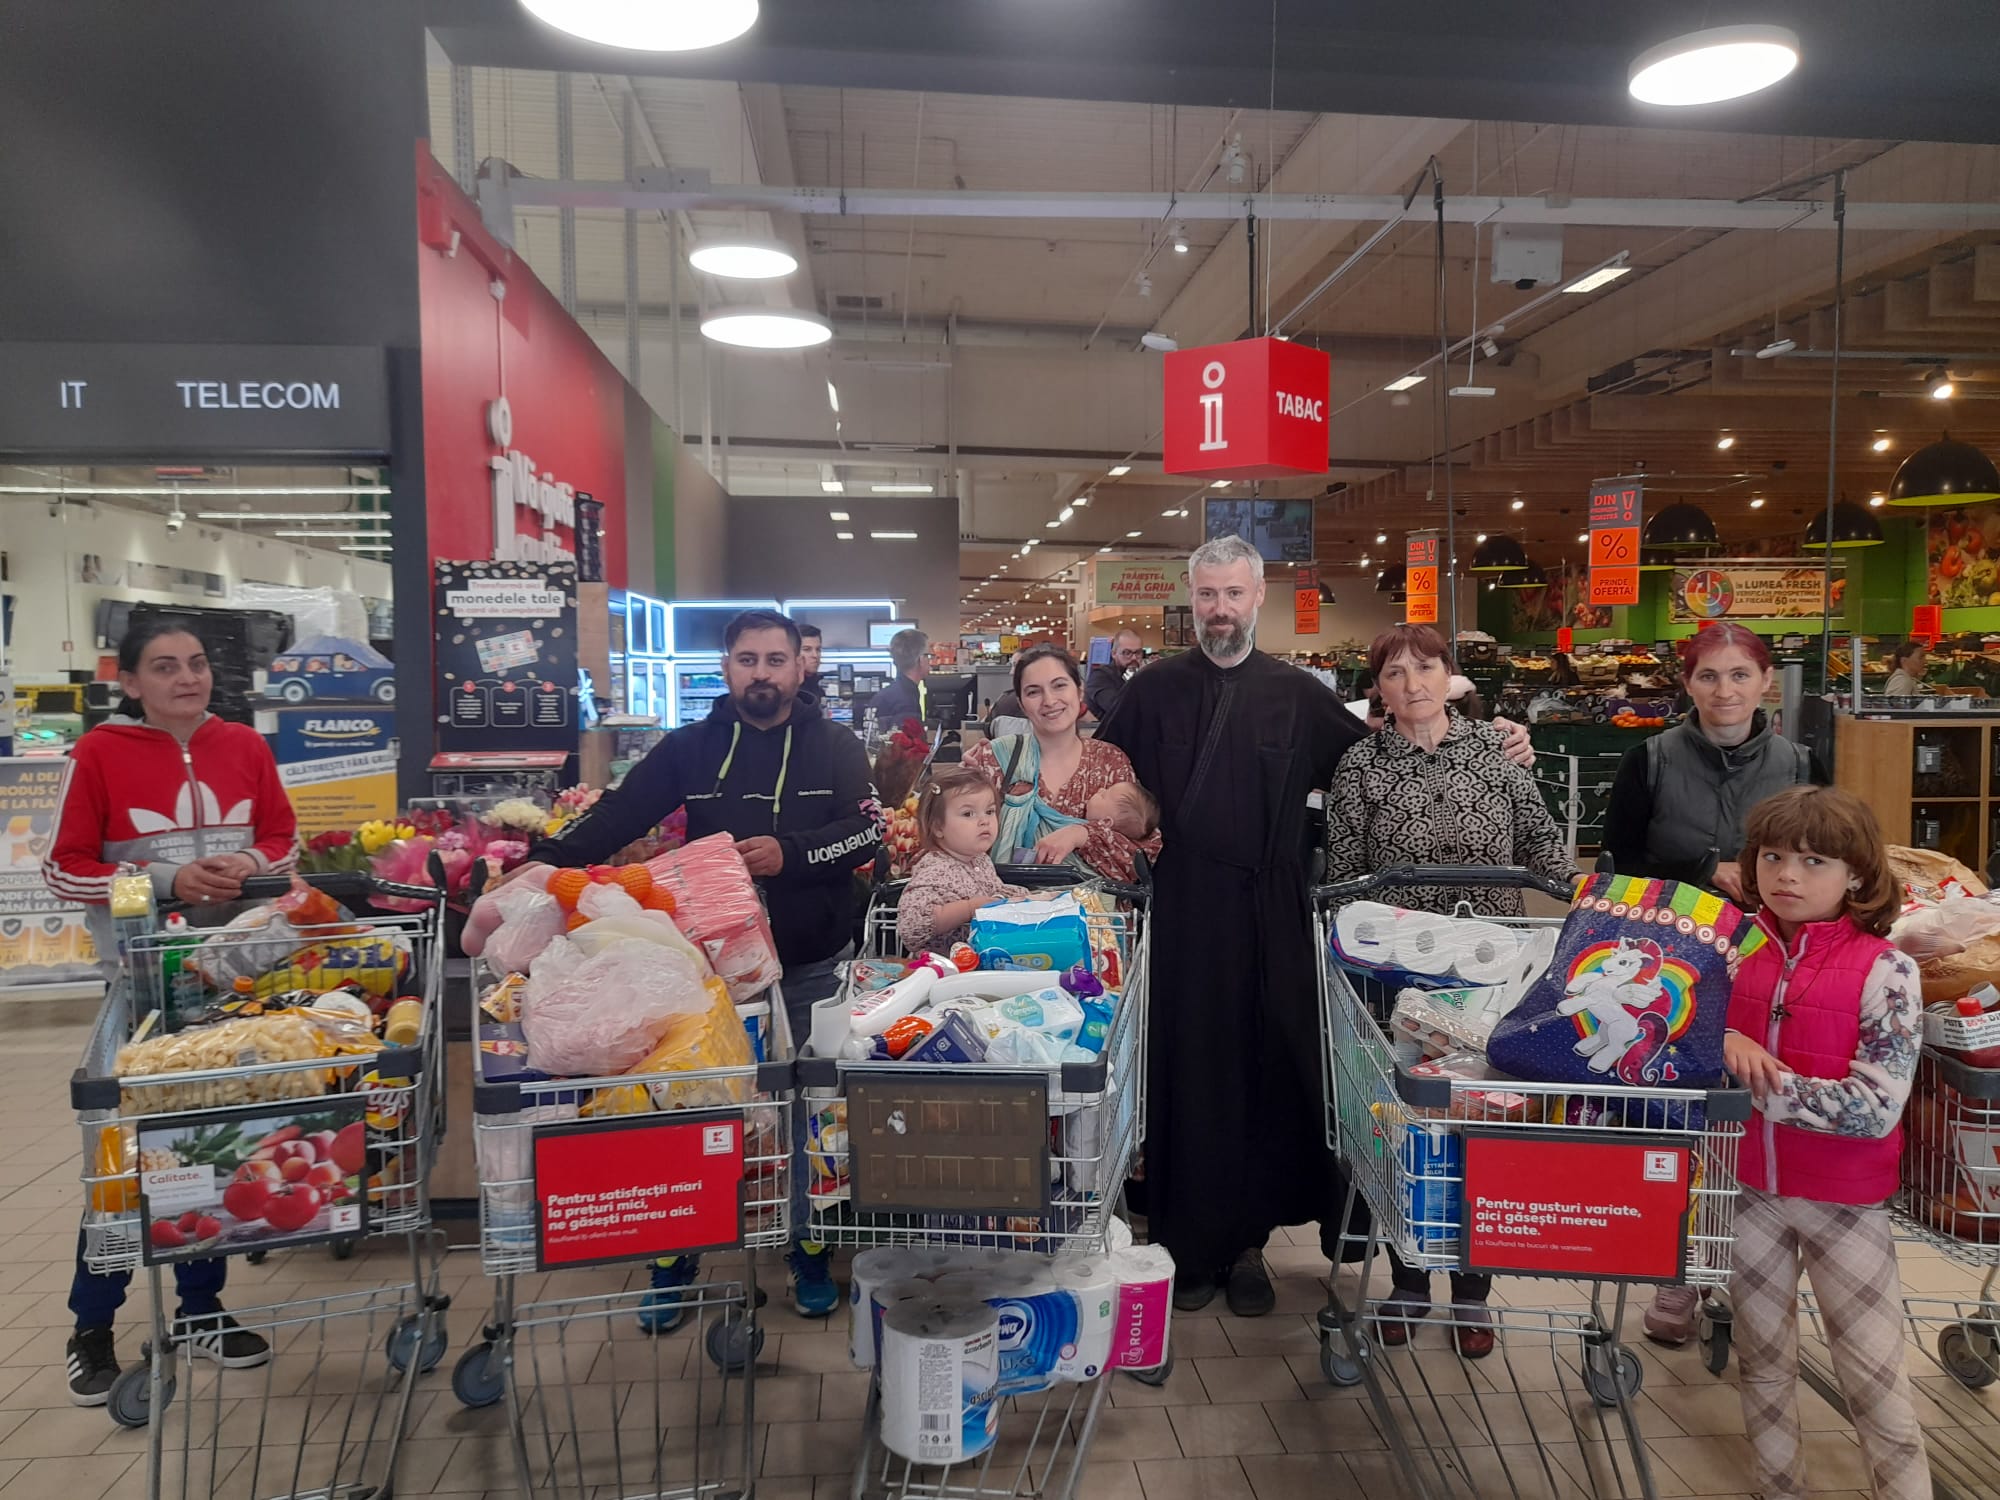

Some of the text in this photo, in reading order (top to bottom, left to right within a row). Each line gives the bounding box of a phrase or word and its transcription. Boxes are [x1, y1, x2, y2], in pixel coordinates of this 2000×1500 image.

[60, 381, 88, 409] IT
[176, 382, 340, 409] TELECOM
[1275, 390, 1323, 423] TABAC
[1593, 494, 1617, 507] DIN
[1593, 586, 1634, 597] OFERTA!
[1599, 578, 1629, 587] PRINDE
[1744, 580, 1783, 590] LUMEA
[1785, 580, 1821, 589] FRESH
[450, 592, 561, 605] monedele tale
[304, 719, 375, 732] FLANCO
[36, 771, 61, 783] DEJ
[0, 785, 46, 797] RODUS
[807, 822, 884, 865] Dimension
[547, 1193, 597, 1207] Pentru
[670, 1180, 703, 1194] mari
[548, 1198, 649, 1219] la prețuri mici,
[1475, 1196, 1643, 1218] Pentru gusturi variate,
[548, 1204, 697, 1231] ne găsești mereu aici.
[1475, 1209, 1608, 1227] aici găsești mereu
[1475, 1222, 1541, 1236] de toate.
[1129, 1303, 1144, 1346] ROLLS
